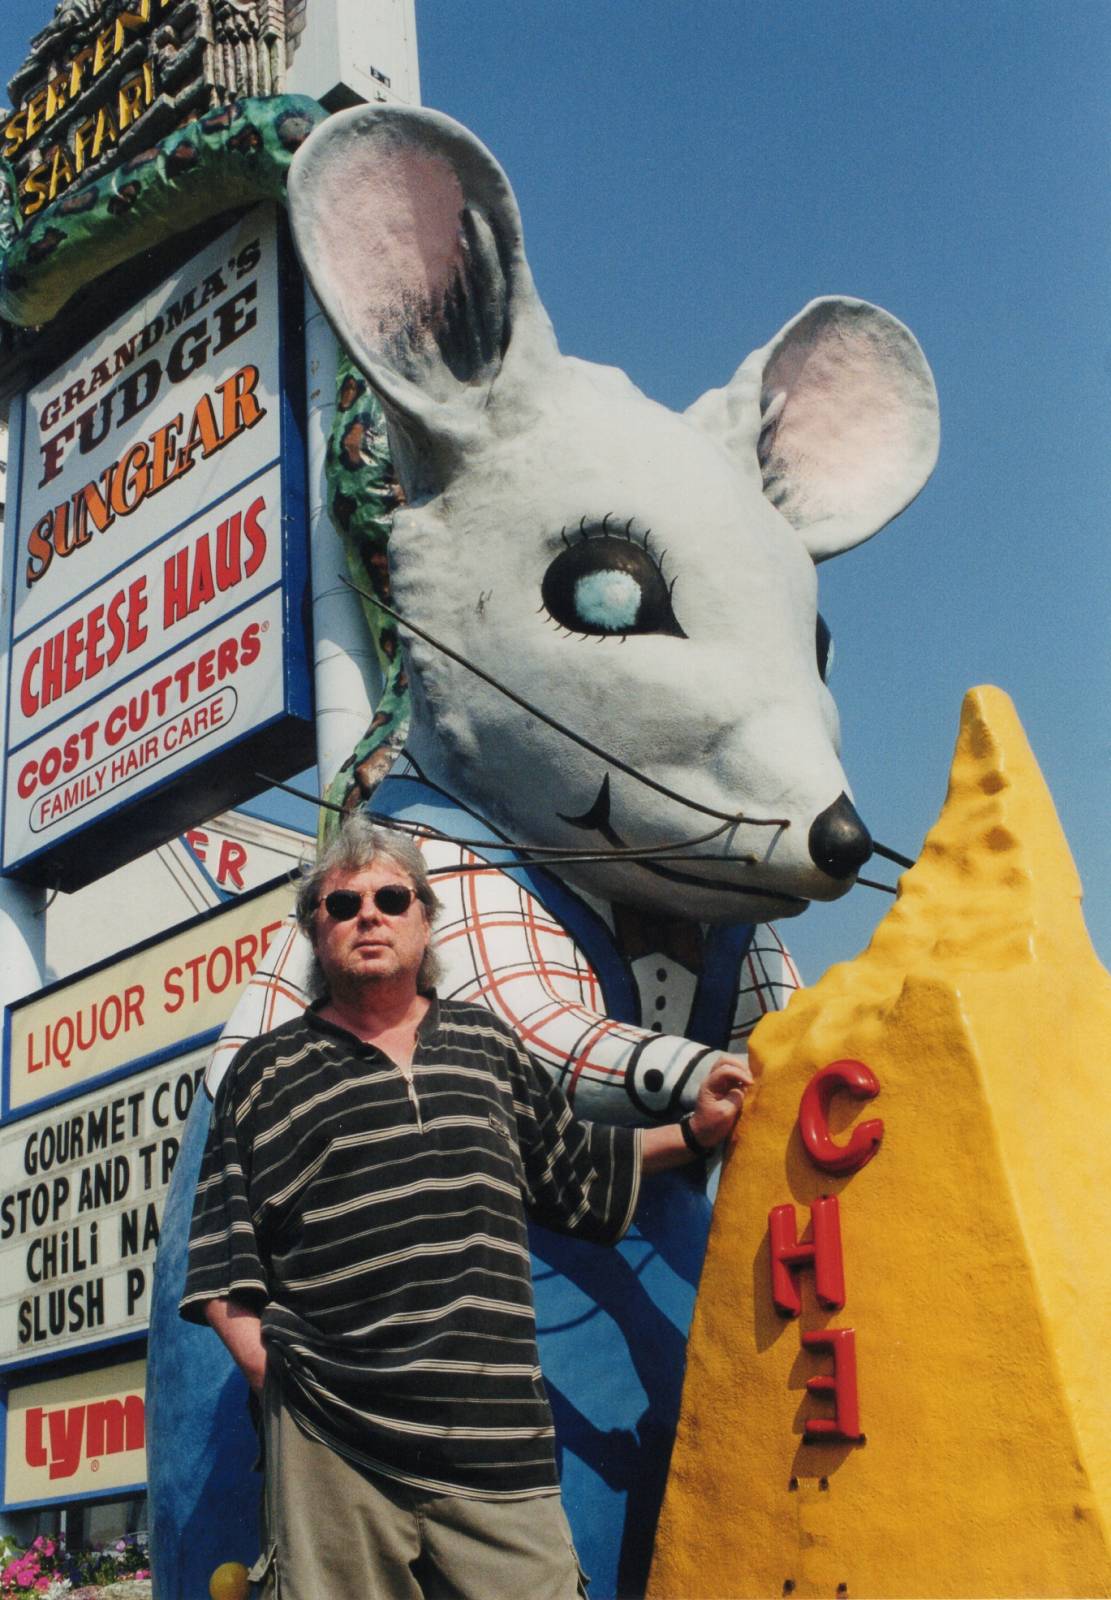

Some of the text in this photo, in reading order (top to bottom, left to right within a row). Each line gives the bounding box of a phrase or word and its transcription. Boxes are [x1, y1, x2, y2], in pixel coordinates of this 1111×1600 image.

[4, 0, 169, 158] SERPEN
[24, 61, 155, 216] SAFARI
[38, 280, 258, 490] FUDGE
[39, 239, 262, 432] GRANDMA'S
[26, 364, 267, 588] SUNGEAR
[20, 496, 267, 719] CHEESE HAUS
[17, 622, 262, 800] COST CUTTERS
[40, 697, 224, 825] FAMILY HAIR CARE
[27, 984, 145, 1074] LIQUOR
[0, 1176, 70, 1239] STOP
[77, 1155, 130, 1213] AND
[24, 1091, 145, 1176] GOURMET
[18, 1260, 157, 1344] SLUSH P
